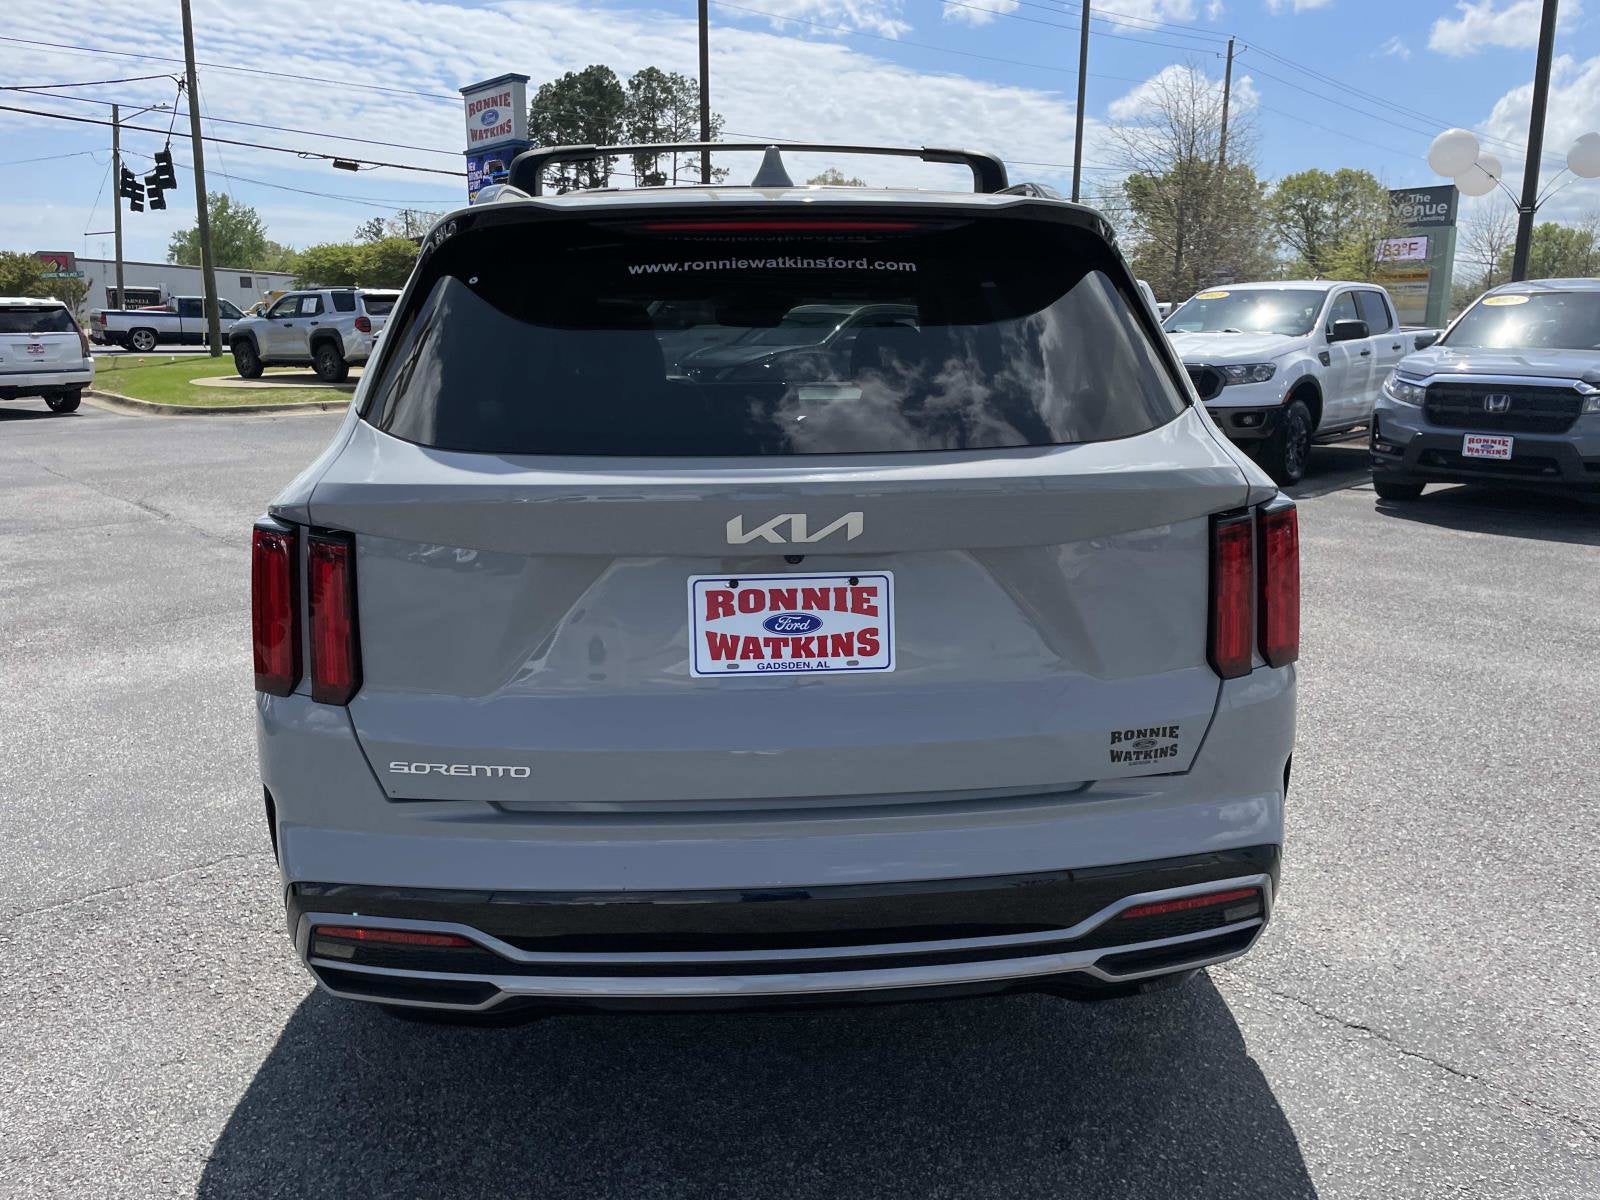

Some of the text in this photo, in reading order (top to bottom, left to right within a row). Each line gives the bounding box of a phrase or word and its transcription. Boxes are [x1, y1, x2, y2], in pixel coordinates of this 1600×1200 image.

[469, 92, 510, 118] RONNIE
[470, 119, 511, 142] WATKINS
[1409, 194, 1431, 203] The
[1391, 203, 1448, 217] Venue
[628, 257, 917, 274] www.ronniewatkinsford.com
[1467, 446, 1508, 455] WATKINS
[1468, 438, 1509, 447] RONNIE
[705, 586, 879, 622] RONNIE
[774, 615, 811, 631] Ford
[705, 627, 880, 661] WATKINS
[757, 661, 830, 670] GADSDEN, AL
[1111, 726, 1179, 744] RONNIE
[1110, 744, 1178, 762] WATKINS
[389, 761, 531, 778] SORENTO
